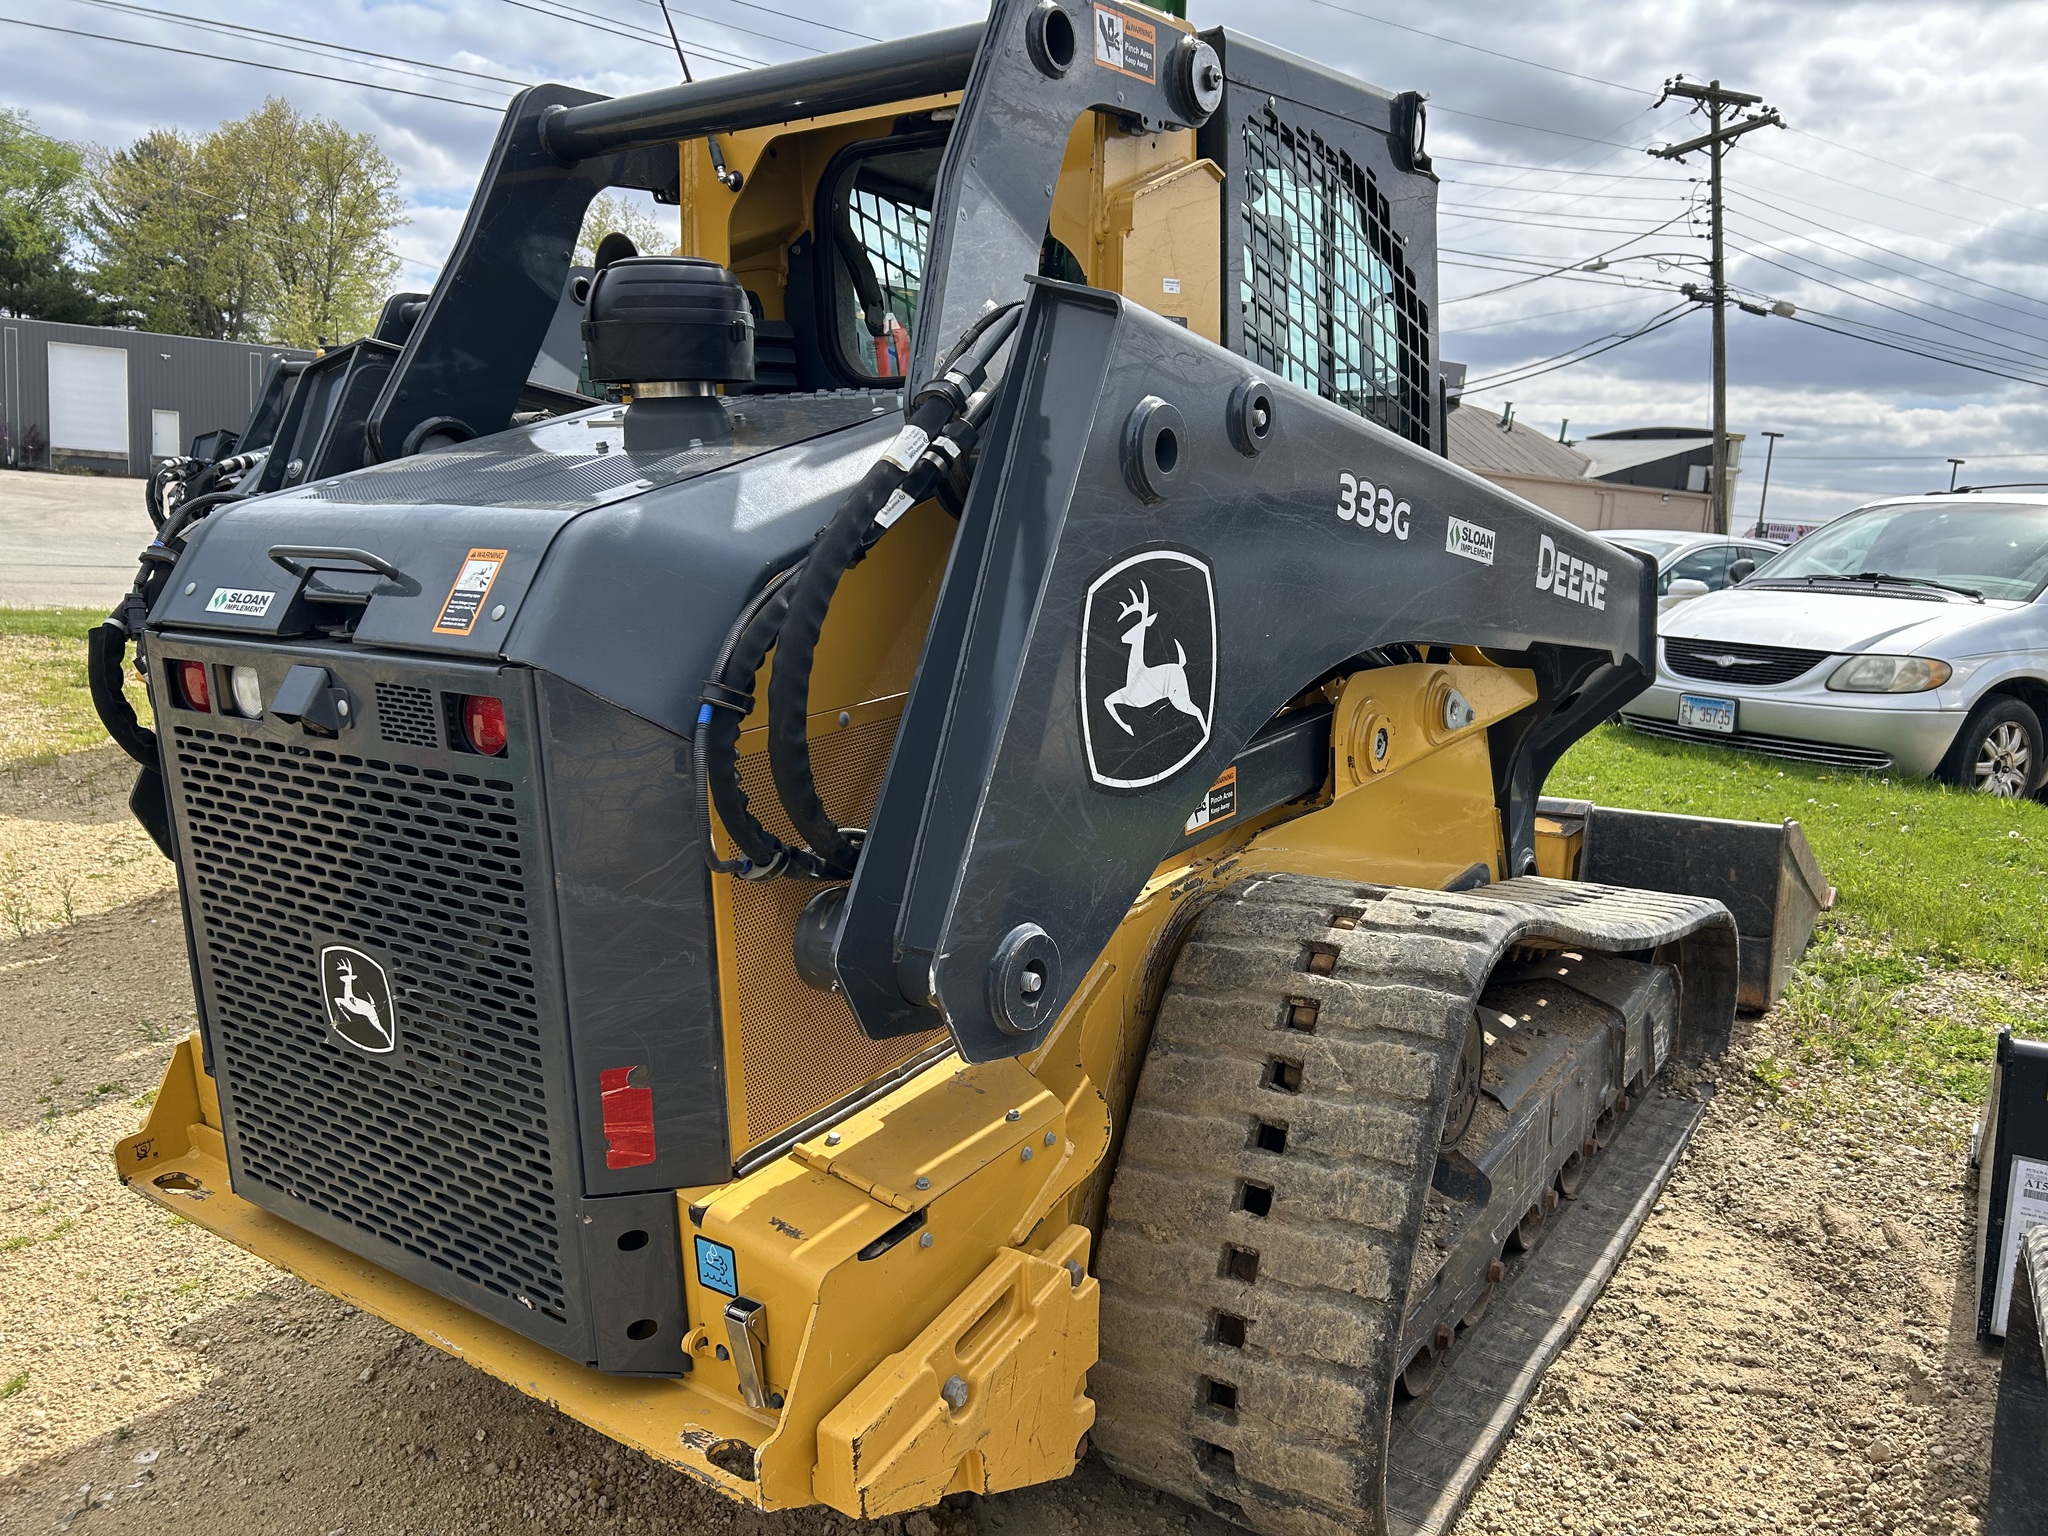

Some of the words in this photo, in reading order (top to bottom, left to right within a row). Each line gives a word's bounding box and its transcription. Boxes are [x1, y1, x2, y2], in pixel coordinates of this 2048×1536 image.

[1124, 41, 1139, 54] Pinch
[1140, 48, 1153, 60] Area
[1124, 55, 1136, 66] Keep
[1136, 59, 1149, 71] Away
[1336, 472, 1411, 541] 333G
[1461, 526, 1494, 550] SLOAN
[476, 551, 504, 559] WARNING
[1460, 543, 1492, 560] IMPLEMENT
[1535, 533, 1609, 611] DEERE
[228, 592, 270, 605] SLOAN
[224, 603, 264, 613] IMPLEMENT
[1682, 704, 1694, 720] FY
[1700, 706, 1731, 726] 35735
